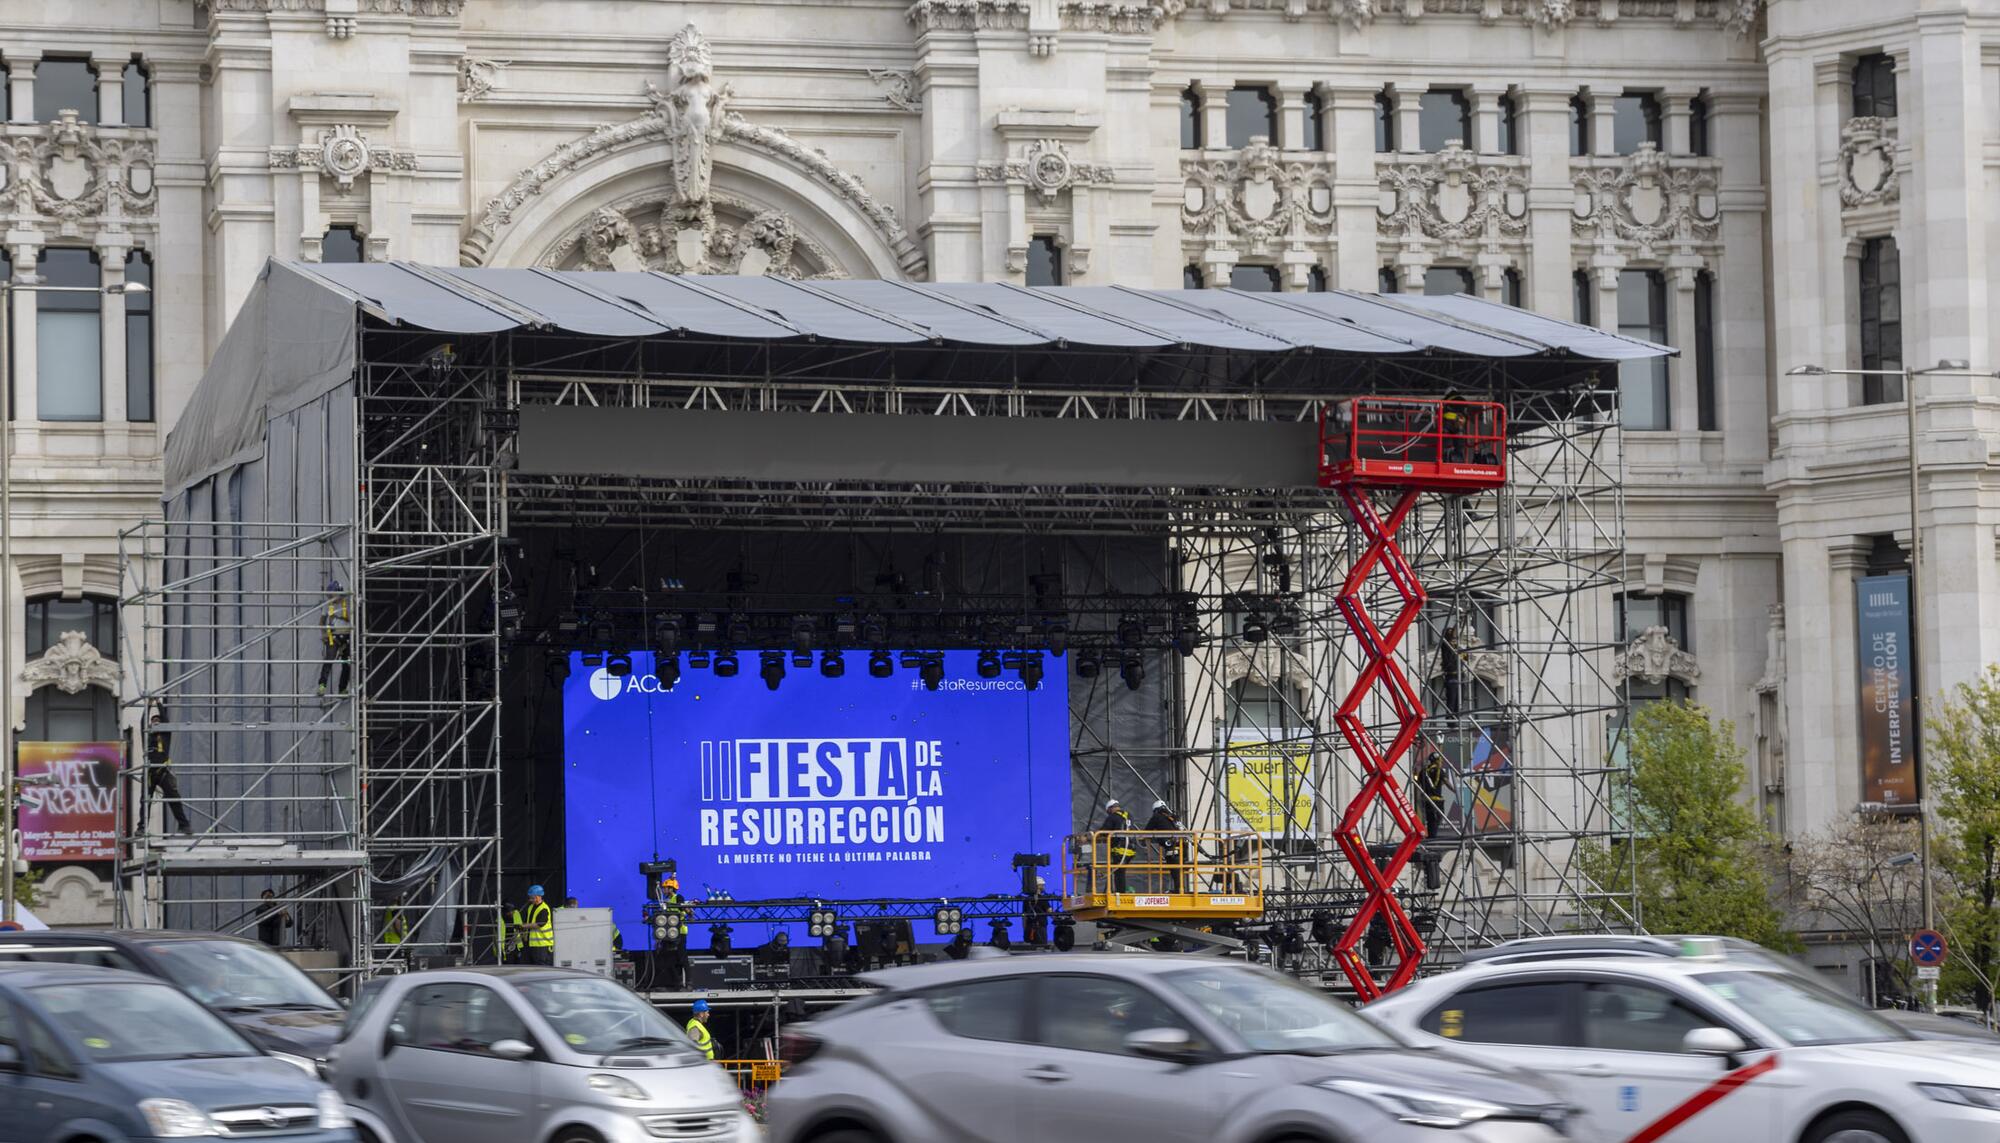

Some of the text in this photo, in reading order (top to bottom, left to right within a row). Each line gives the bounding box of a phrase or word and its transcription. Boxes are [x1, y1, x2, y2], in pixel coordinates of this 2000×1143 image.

[1872, 631, 1887, 713] CENTRO DE
[1884, 631, 1902, 764] INTERPRETACIÓN
[915, 740, 943, 767] DE
[737, 740, 906, 799] FIESTA
[916, 770, 943, 796] LA
[80, 830, 91, 839] de
[700, 797, 945, 847] RESURRECCIÓN
[42, 840, 49, 849] y
[718, 850, 931, 864] LA MUERTE NO TIENE LA ÚLTIMA PALABRA
